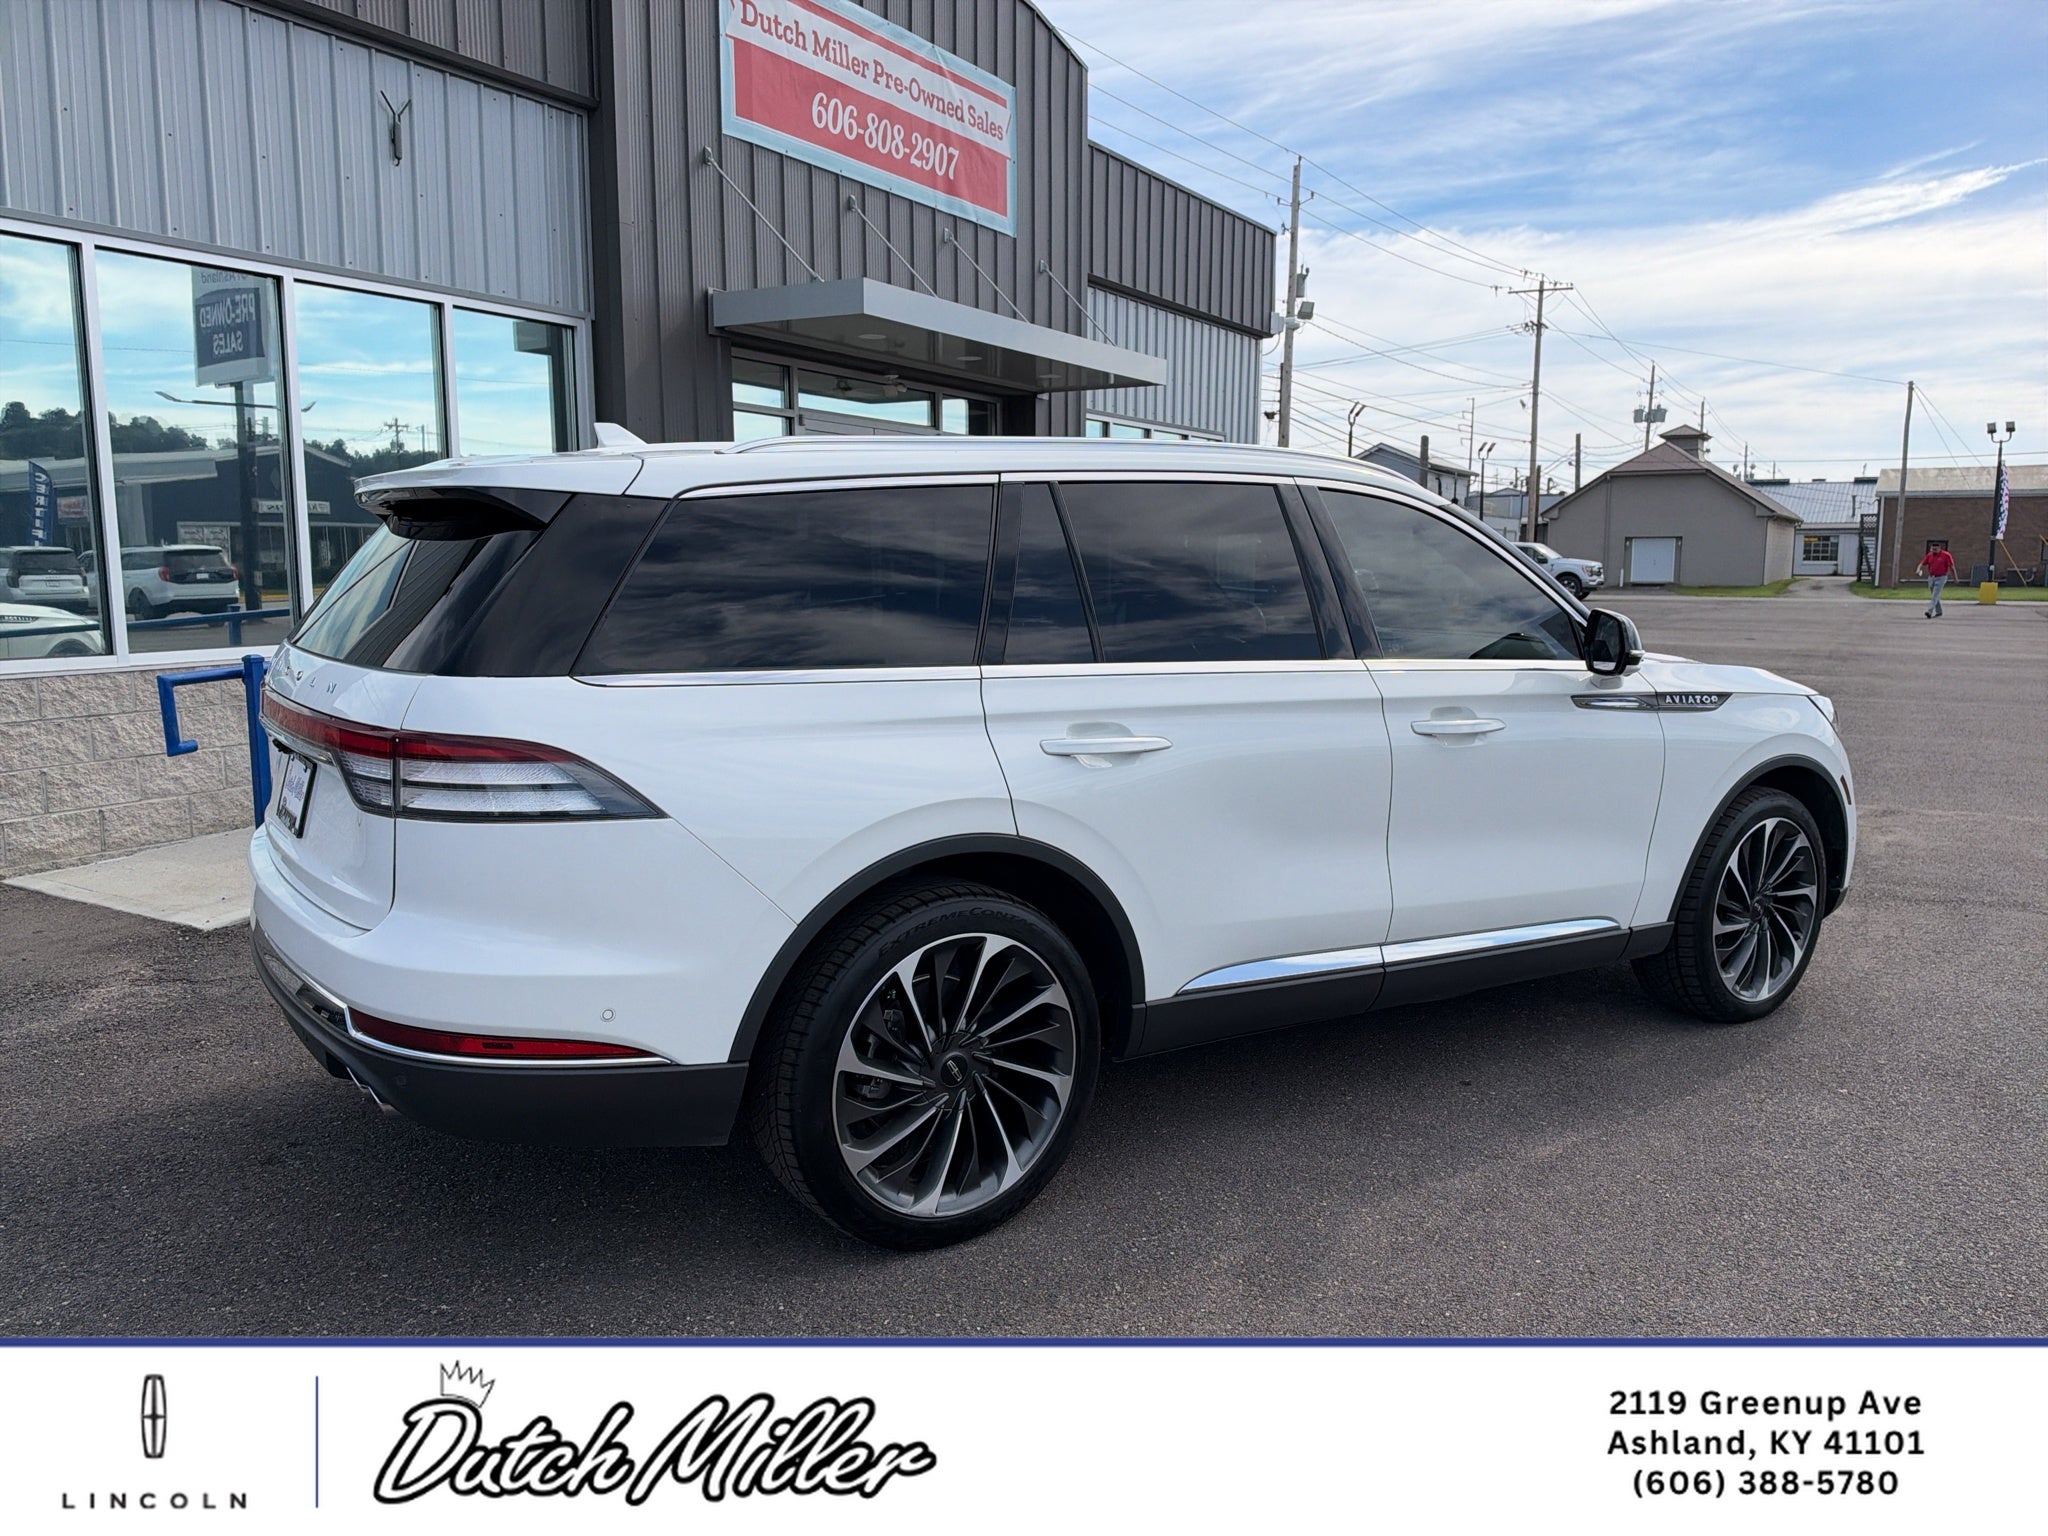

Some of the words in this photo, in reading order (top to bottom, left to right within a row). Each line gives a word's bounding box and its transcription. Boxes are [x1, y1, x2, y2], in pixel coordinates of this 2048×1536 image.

[741, 0, 807, 52] Dutch
[812, 30, 870, 79] Miller
[873, 58, 965, 123] Pre-Owned
[968, 104, 1004, 142] Sales
[811, 92, 959, 180] 606-808-2907
[1665, 694, 1719, 704] AVIATOR
